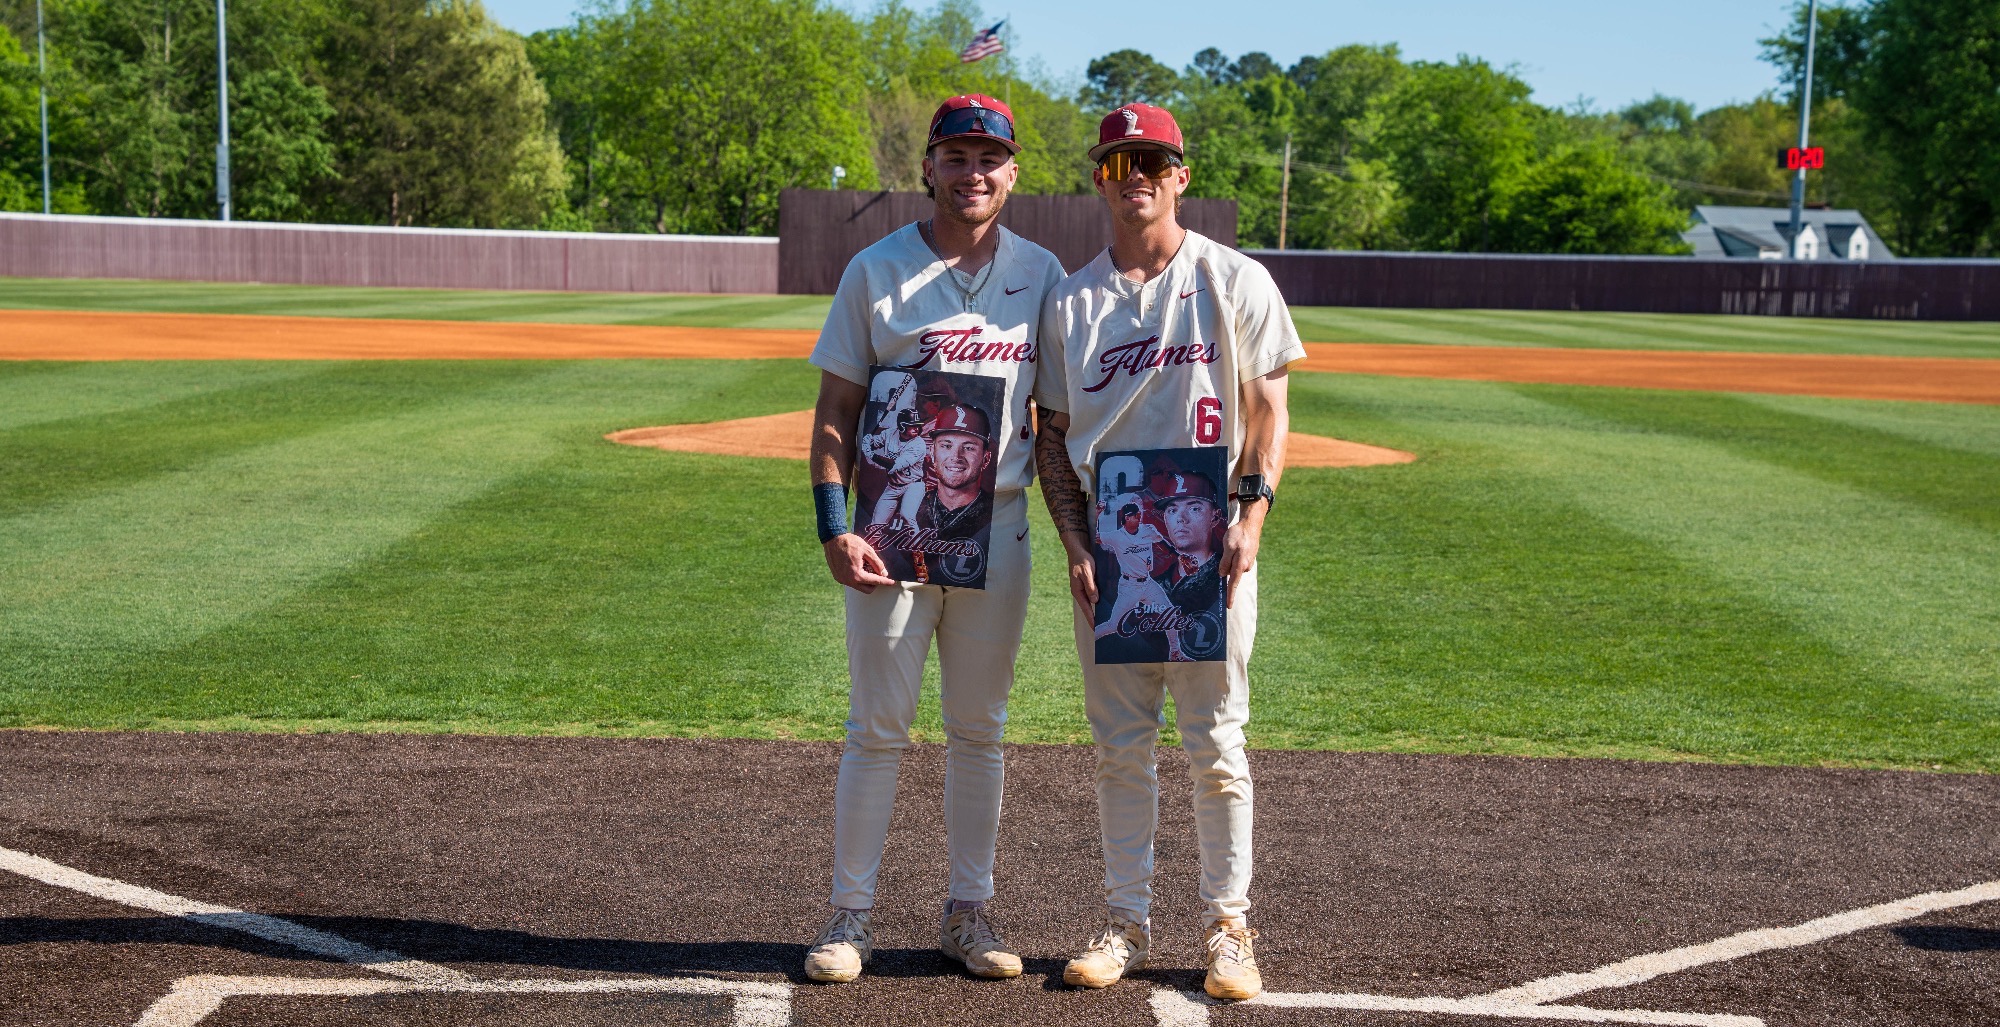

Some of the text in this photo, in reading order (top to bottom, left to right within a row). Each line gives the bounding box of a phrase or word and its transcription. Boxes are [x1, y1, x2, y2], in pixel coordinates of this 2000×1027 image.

[1787, 147, 1824, 170] 020
[898, 326, 1037, 369] Flames
[1082, 334, 1221, 393] Flames
[1193, 396, 1222, 447] 6
[863, 522, 980, 558] Williams
[1117, 606, 1197, 638] Collier
[1134, 600, 1167, 614] Luke
